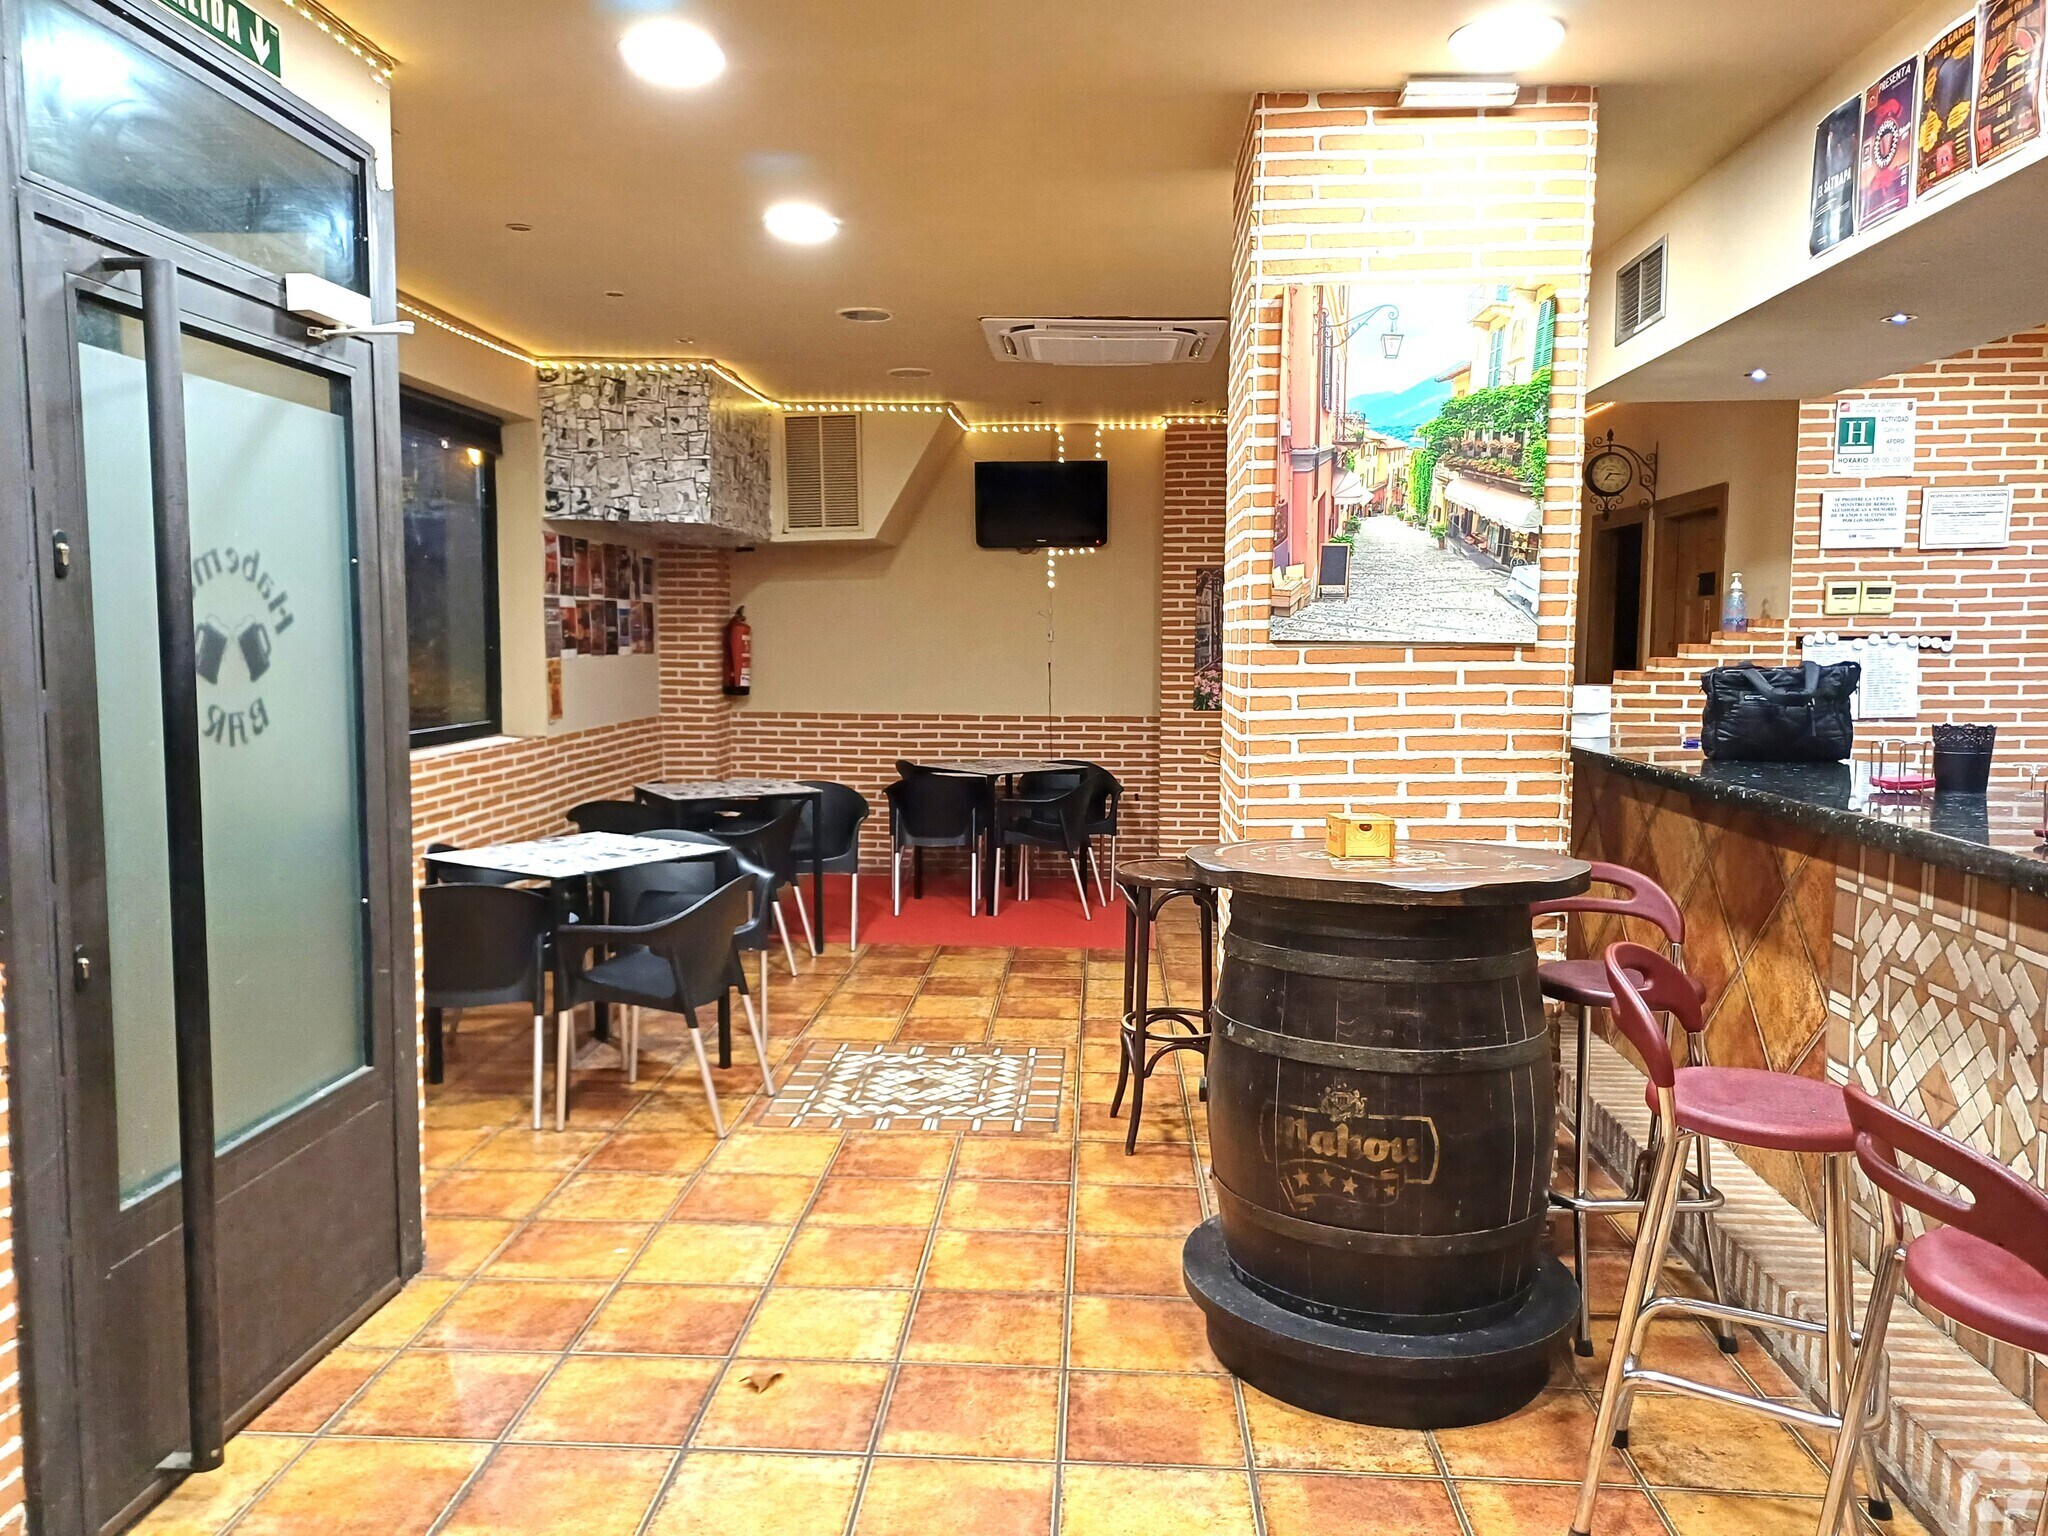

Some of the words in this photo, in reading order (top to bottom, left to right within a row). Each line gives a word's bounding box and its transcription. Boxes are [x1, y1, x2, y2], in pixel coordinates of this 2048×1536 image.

[172, 0, 242, 45] LIDA
[1878, 63, 1911, 93] PRESENTA
[1845, 421, 1869, 444] H
[1280, 1115, 1420, 1164] Mahou
